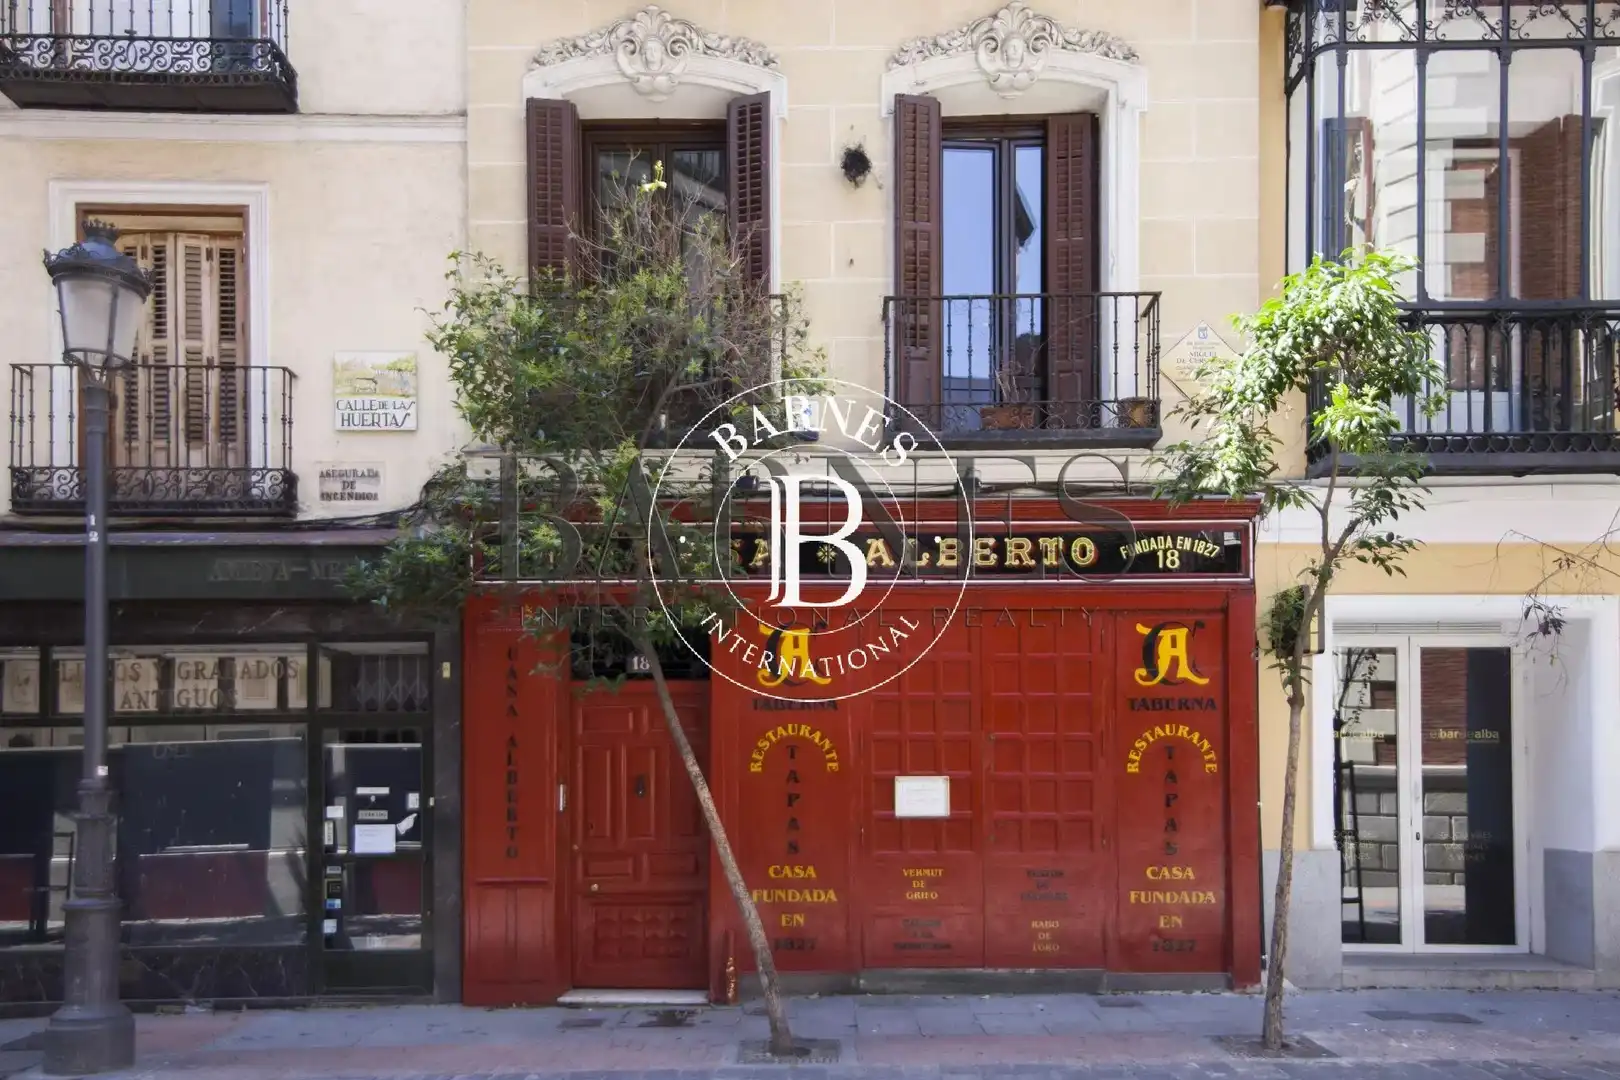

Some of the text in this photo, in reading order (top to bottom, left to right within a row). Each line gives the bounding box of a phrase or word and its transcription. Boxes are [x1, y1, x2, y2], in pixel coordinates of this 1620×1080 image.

[336, 400, 416, 411] CALLE DE LAS
[341, 412, 411, 428] HUERTAS
[342, 480, 357, 490] DE
[866, 537, 1098, 568] ALBERTO
[1119, 535, 1221, 559] FUNDADA EN 1827
[1157, 549, 1181, 569] 18
[632, 655, 651, 671] 18
[1128, 697, 1217, 711] TABERNA
[750, 724, 839, 773] RESTAURANTE
[1127, 724, 1218, 774] RESTAURANTE
[768, 865, 817, 879] CASA
[902, 868, 944, 877] VERMUT
[1146, 866, 1196, 880] CASA
[752, 889, 838, 903] FUNDADA
[1129, 890, 1217, 904] FUNDADA
[781, 914, 805, 927] EN
[1159, 915, 1183, 928] EN
